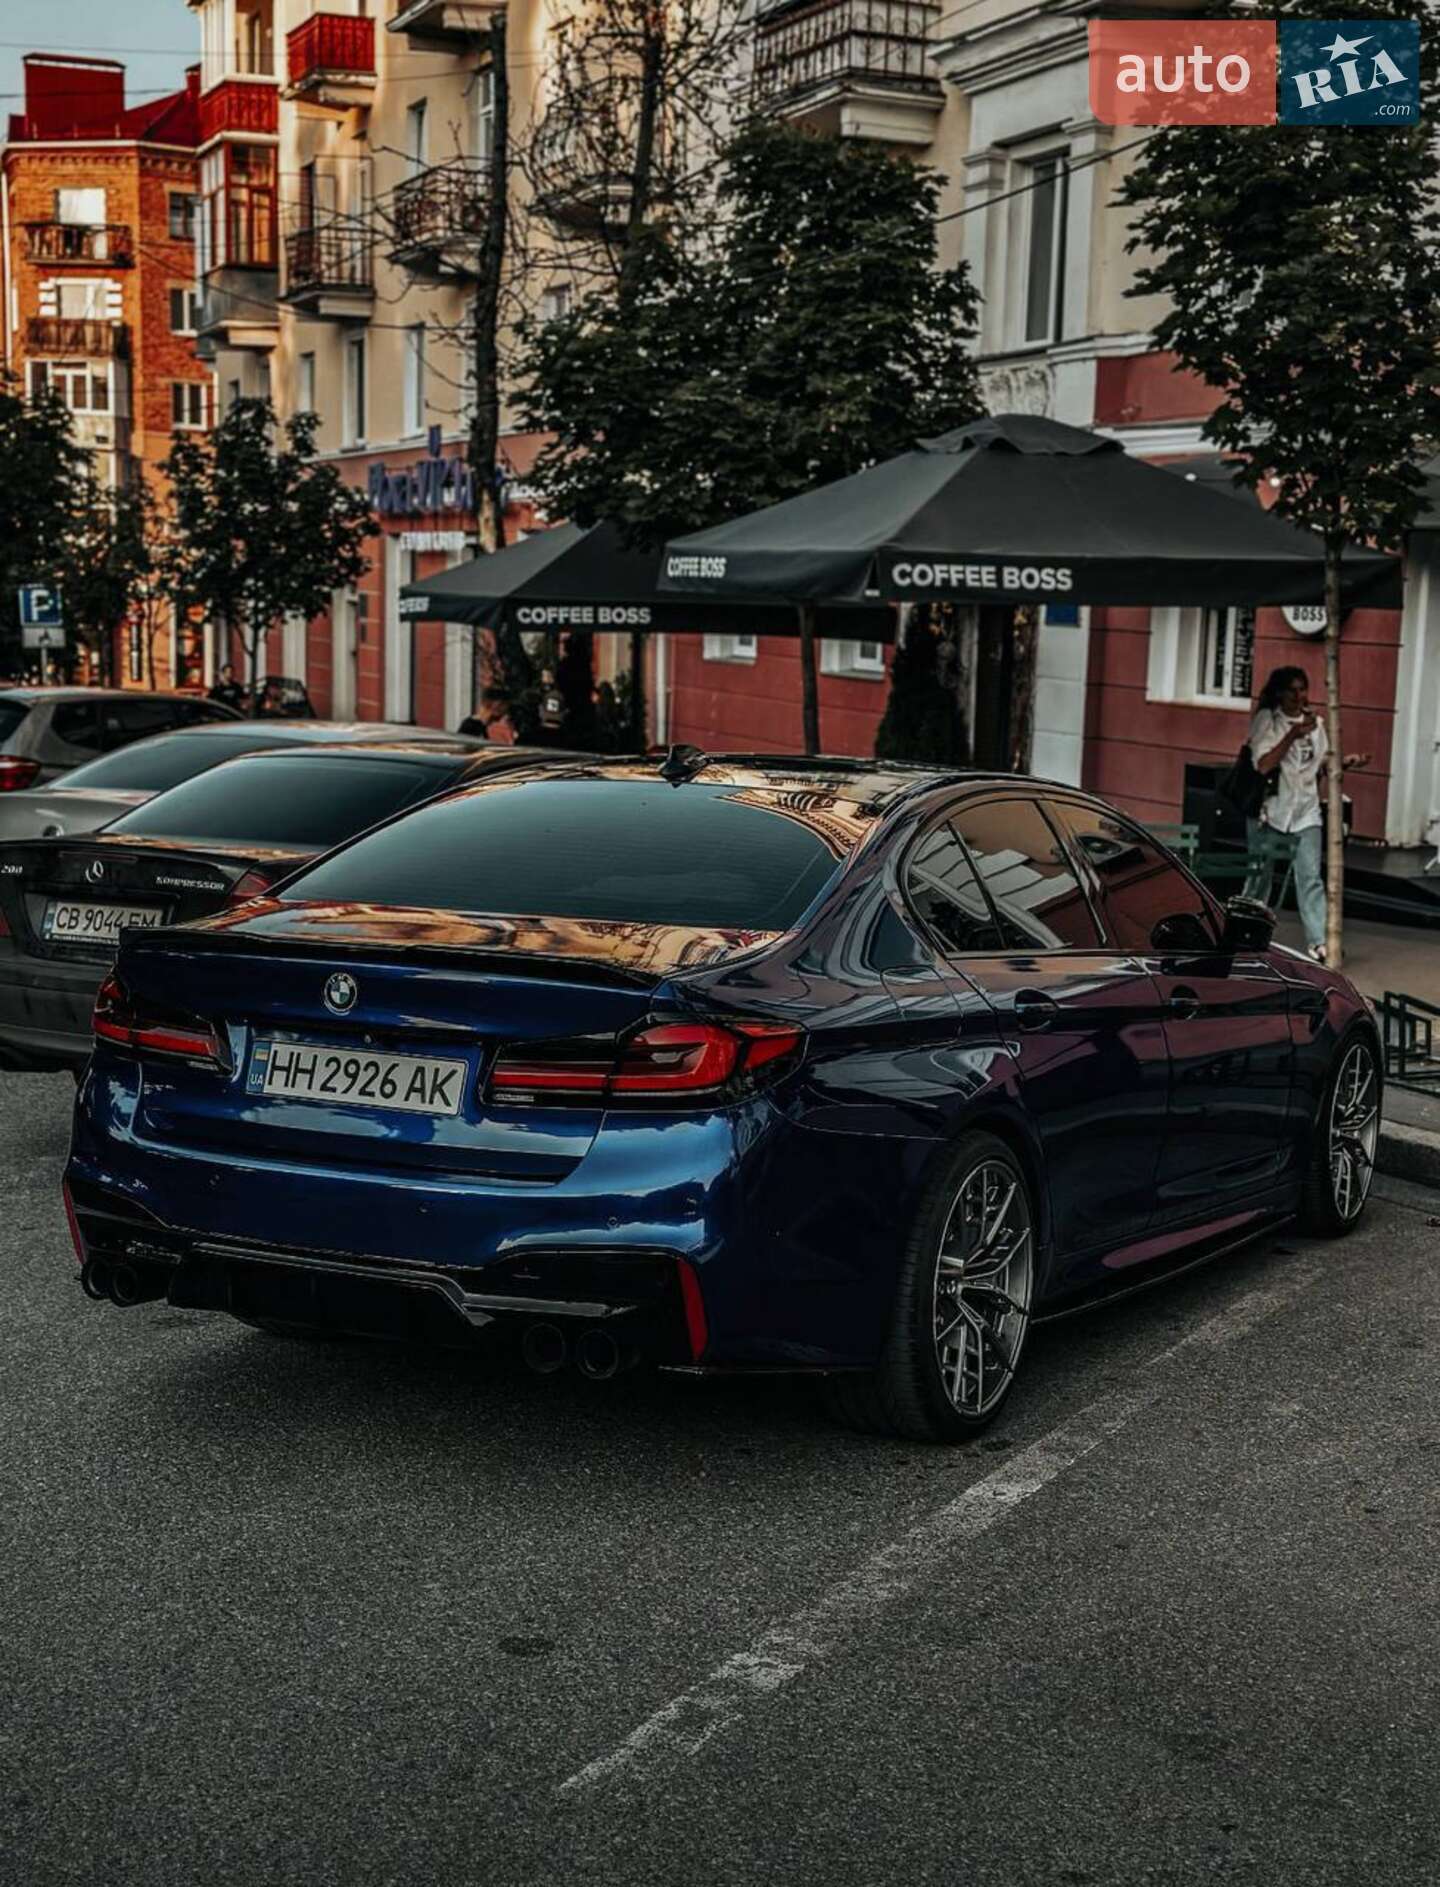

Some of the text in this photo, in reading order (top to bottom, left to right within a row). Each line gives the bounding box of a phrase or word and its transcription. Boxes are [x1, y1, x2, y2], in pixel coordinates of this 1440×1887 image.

[668, 557, 727, 578] COFFEE BOSS
[892, 563, 1072, 590] COFFEE BOSS
[517, 606, 650, 623] COFFEE BOSS
[1293, 606, 1323, 622] BOSS
[56, 907, 80, 930] CB
[83, 909, 124, 933] 9044
[251, 1072, 263, 1085] UA
[268, 1050, 457, 1107] HH 2926 AK
